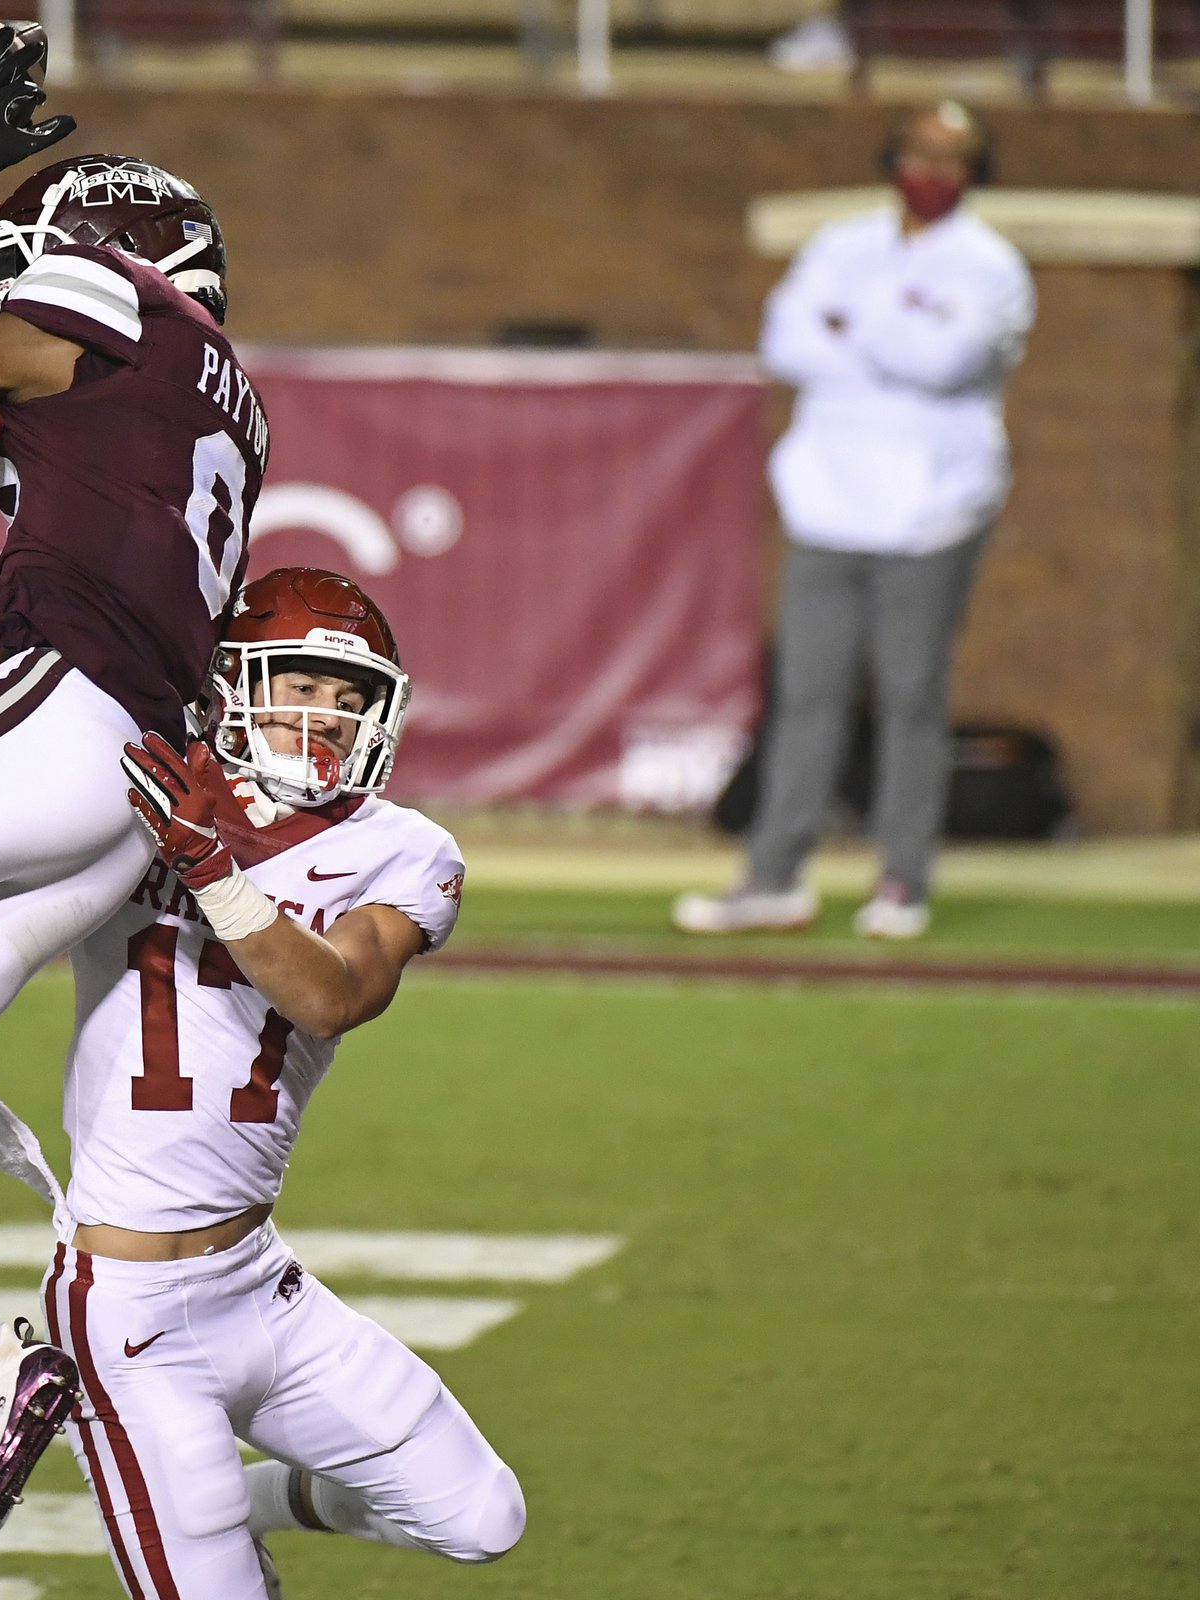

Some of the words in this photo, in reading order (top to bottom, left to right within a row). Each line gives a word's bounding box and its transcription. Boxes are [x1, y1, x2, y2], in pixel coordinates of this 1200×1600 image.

[86, 170, 151, 187] STATE
[184, 429, 246, 620] 0
[127, 922, 294, 1123] 17
